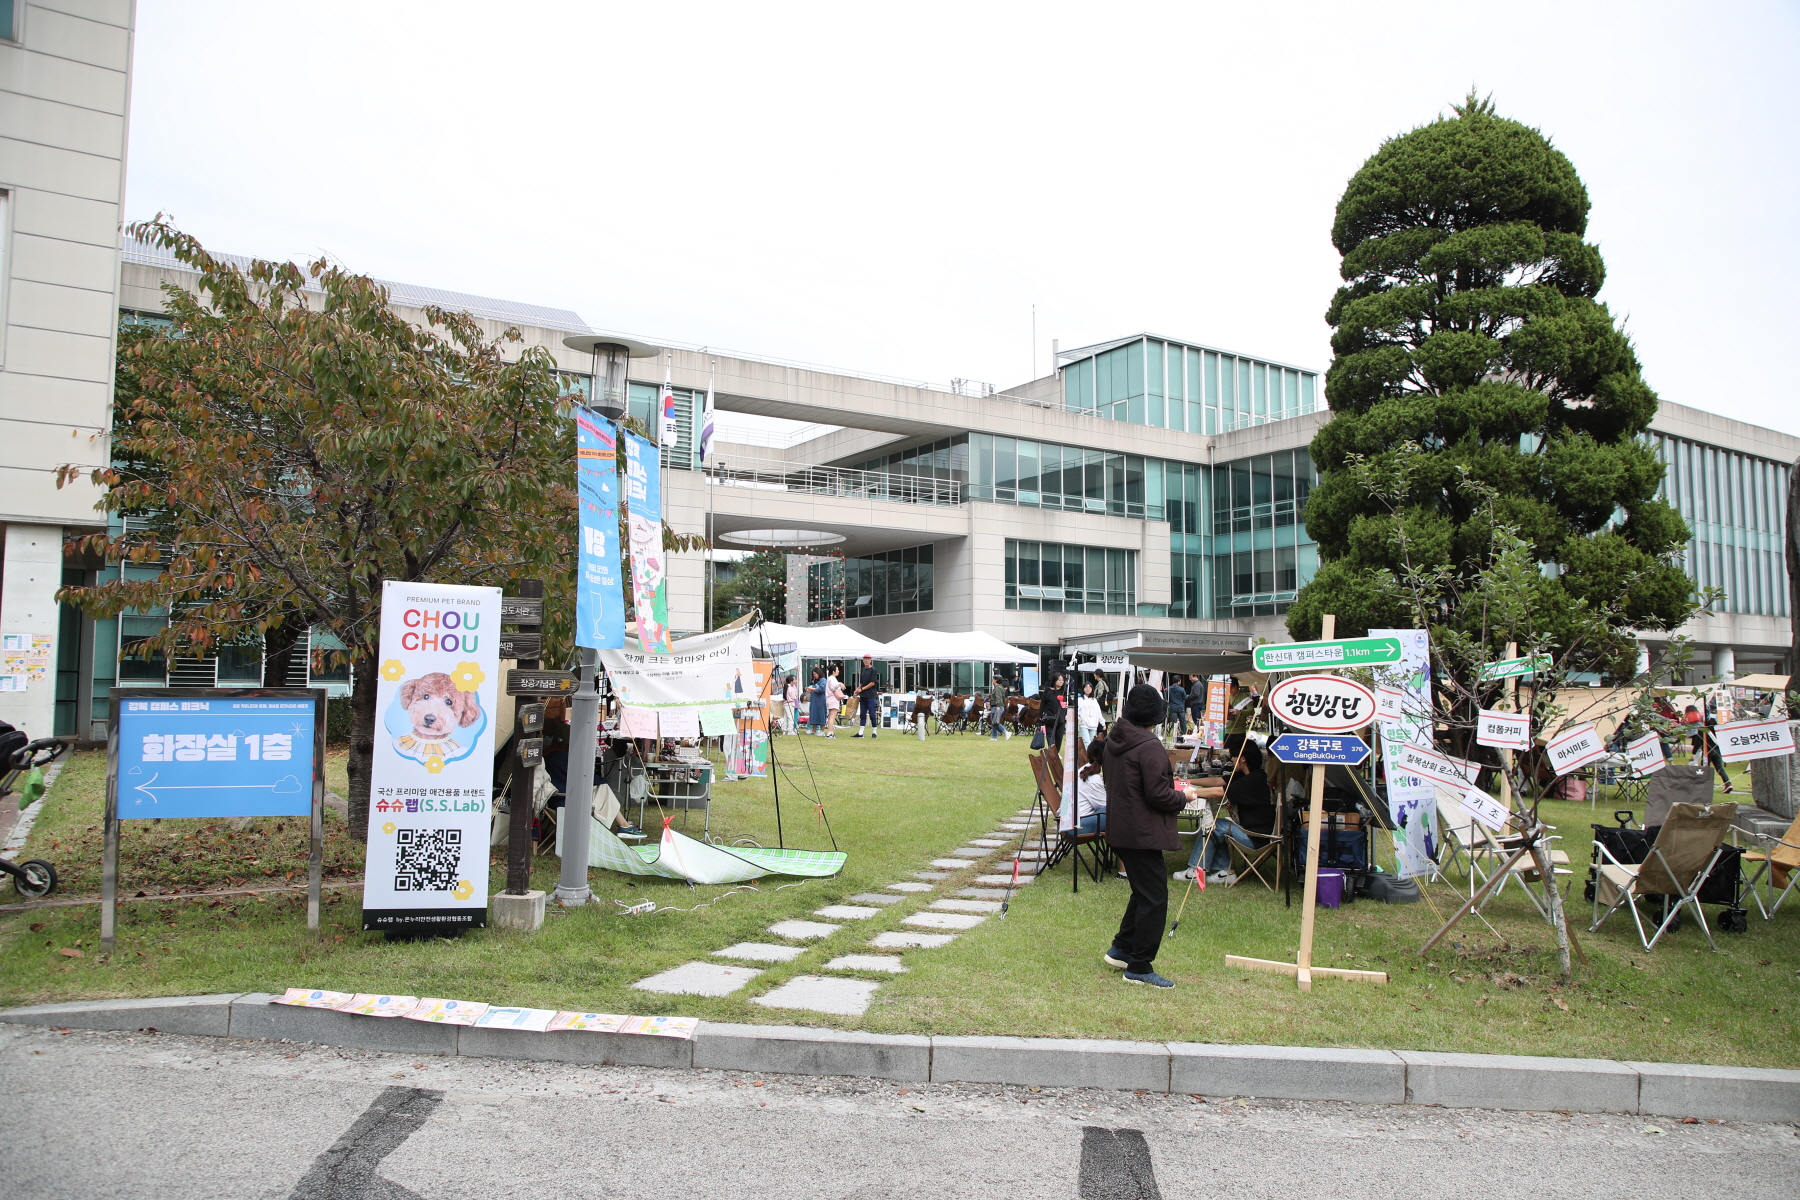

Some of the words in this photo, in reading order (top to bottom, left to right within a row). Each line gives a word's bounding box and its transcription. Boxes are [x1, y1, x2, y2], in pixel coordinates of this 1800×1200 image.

[406, 596, 440, 604] PREMIUM
[403, 608, 480, 630] CHOU
[401, 631, 479, 653] CHOU
[648, 656, 670, 665] 크는
[673, 654, 706, 665] 엄마와
[709, 646, 730, 658] 아이
[1264, 650, 1293, 663] 한신대
[1296, 648, 1343, 661] 캠퍼스타운
[1345, 648, 1370, 657] 1.1km
[520, 678, 556, 689] 장공기념관
[128, 701, 148, 711] 강북
[150, 701, 179, 711] 캠퍼스
[181, 702, 210, 711] 피크닉
[1285, 687, 1362, 720] 청년상단
[1297, 738, 1343, 752] 강북구로
[1730, 731, 1780, 747] 오늘멋지음
[142, 733, 238, 762] 화장실
[244, 732, 293, 761] 1층
[1557, 739, 1591, 760] 마시미트
[1293, 752, 1346, 760] GangBukGu-ro
[377, 787, 393, 796] 국산
[395, 787, 427, 797] 프리미엄
[429, 788, 460, 797] 애견용품
[463, 788, 486, 797] 브랜드
[376, 798, 486, 813] 슈슈랩(S.S.Lab)
